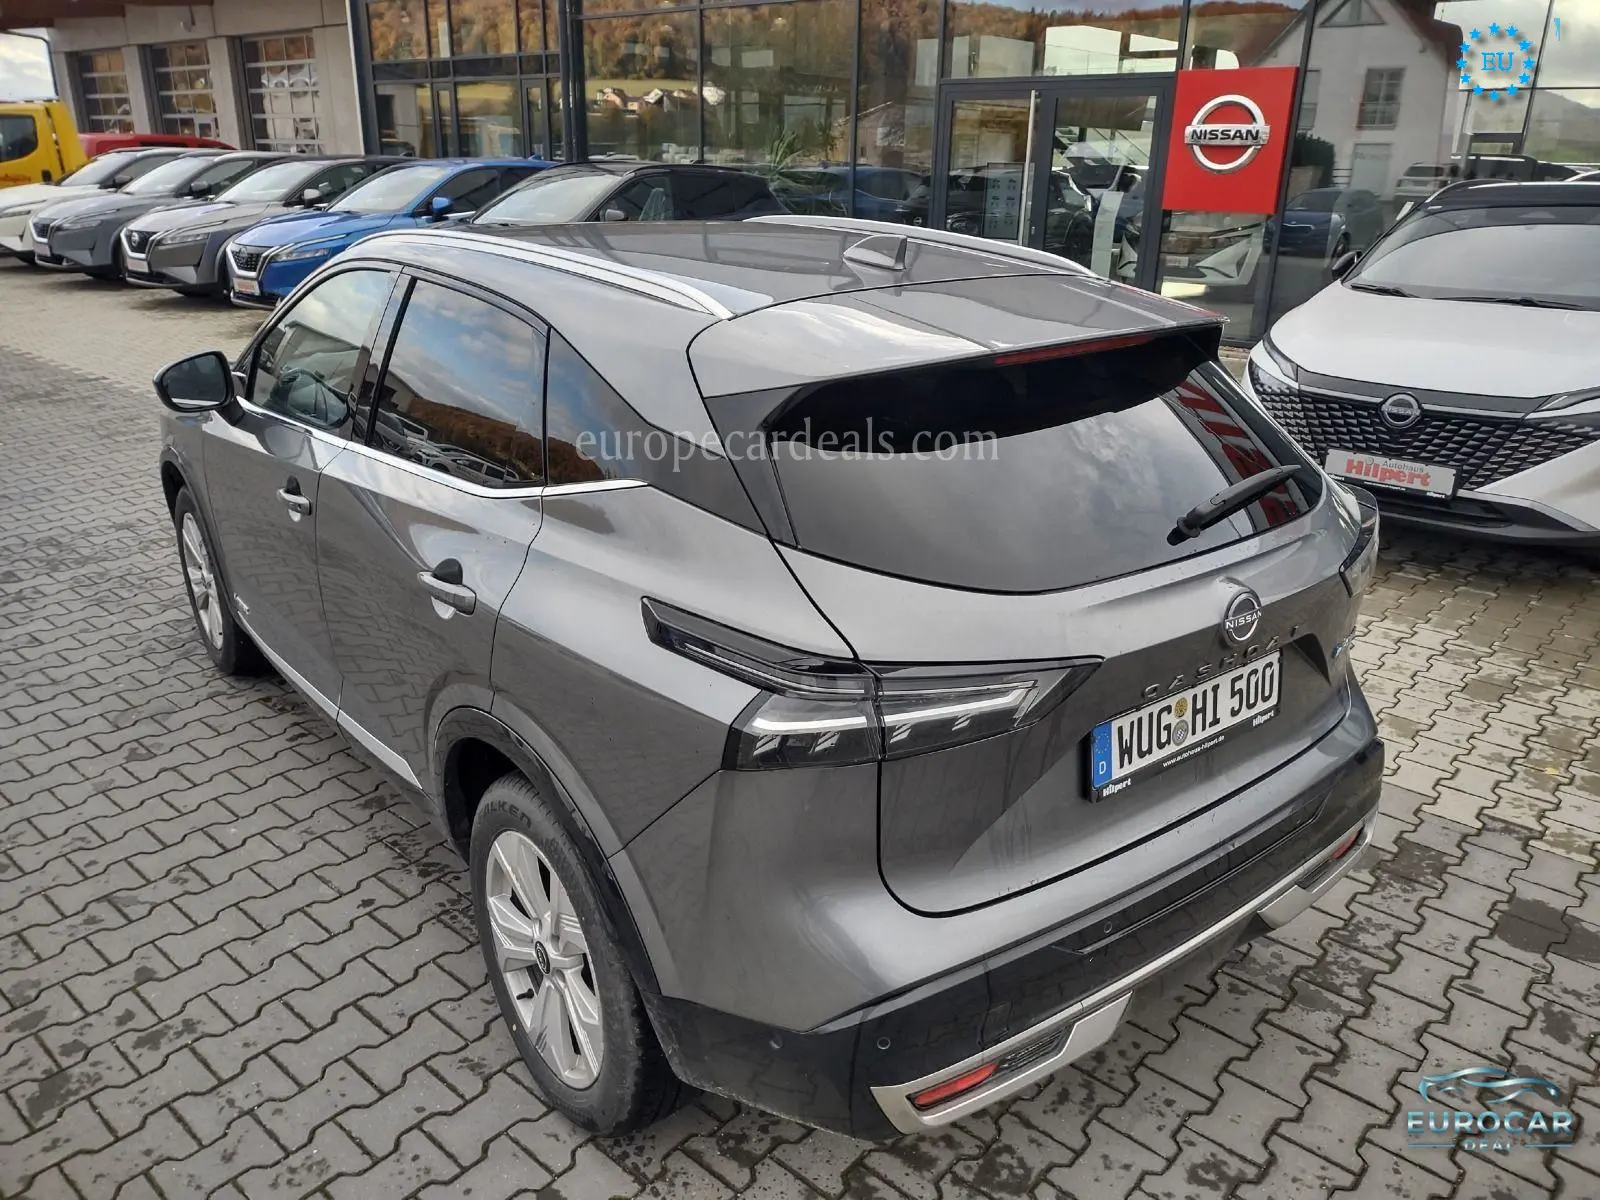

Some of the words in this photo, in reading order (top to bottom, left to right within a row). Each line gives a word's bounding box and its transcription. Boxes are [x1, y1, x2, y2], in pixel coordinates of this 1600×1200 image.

[1190, 129, 1260, 141] NISSAN
[1345, 458, 1432, 487] Hilpert
[1383, 459, 1425, 473] Autohaus
[1225, 610, 1263, 630] NISSAN
[1117, 703, 1173, 769] WUG
[1191, 683, 1220, 736] HI
[1230, 660, 1275, 718] 500
[1099, 761, 1107, 775] D
[1102, 777, 1132, 797] Hilpert
